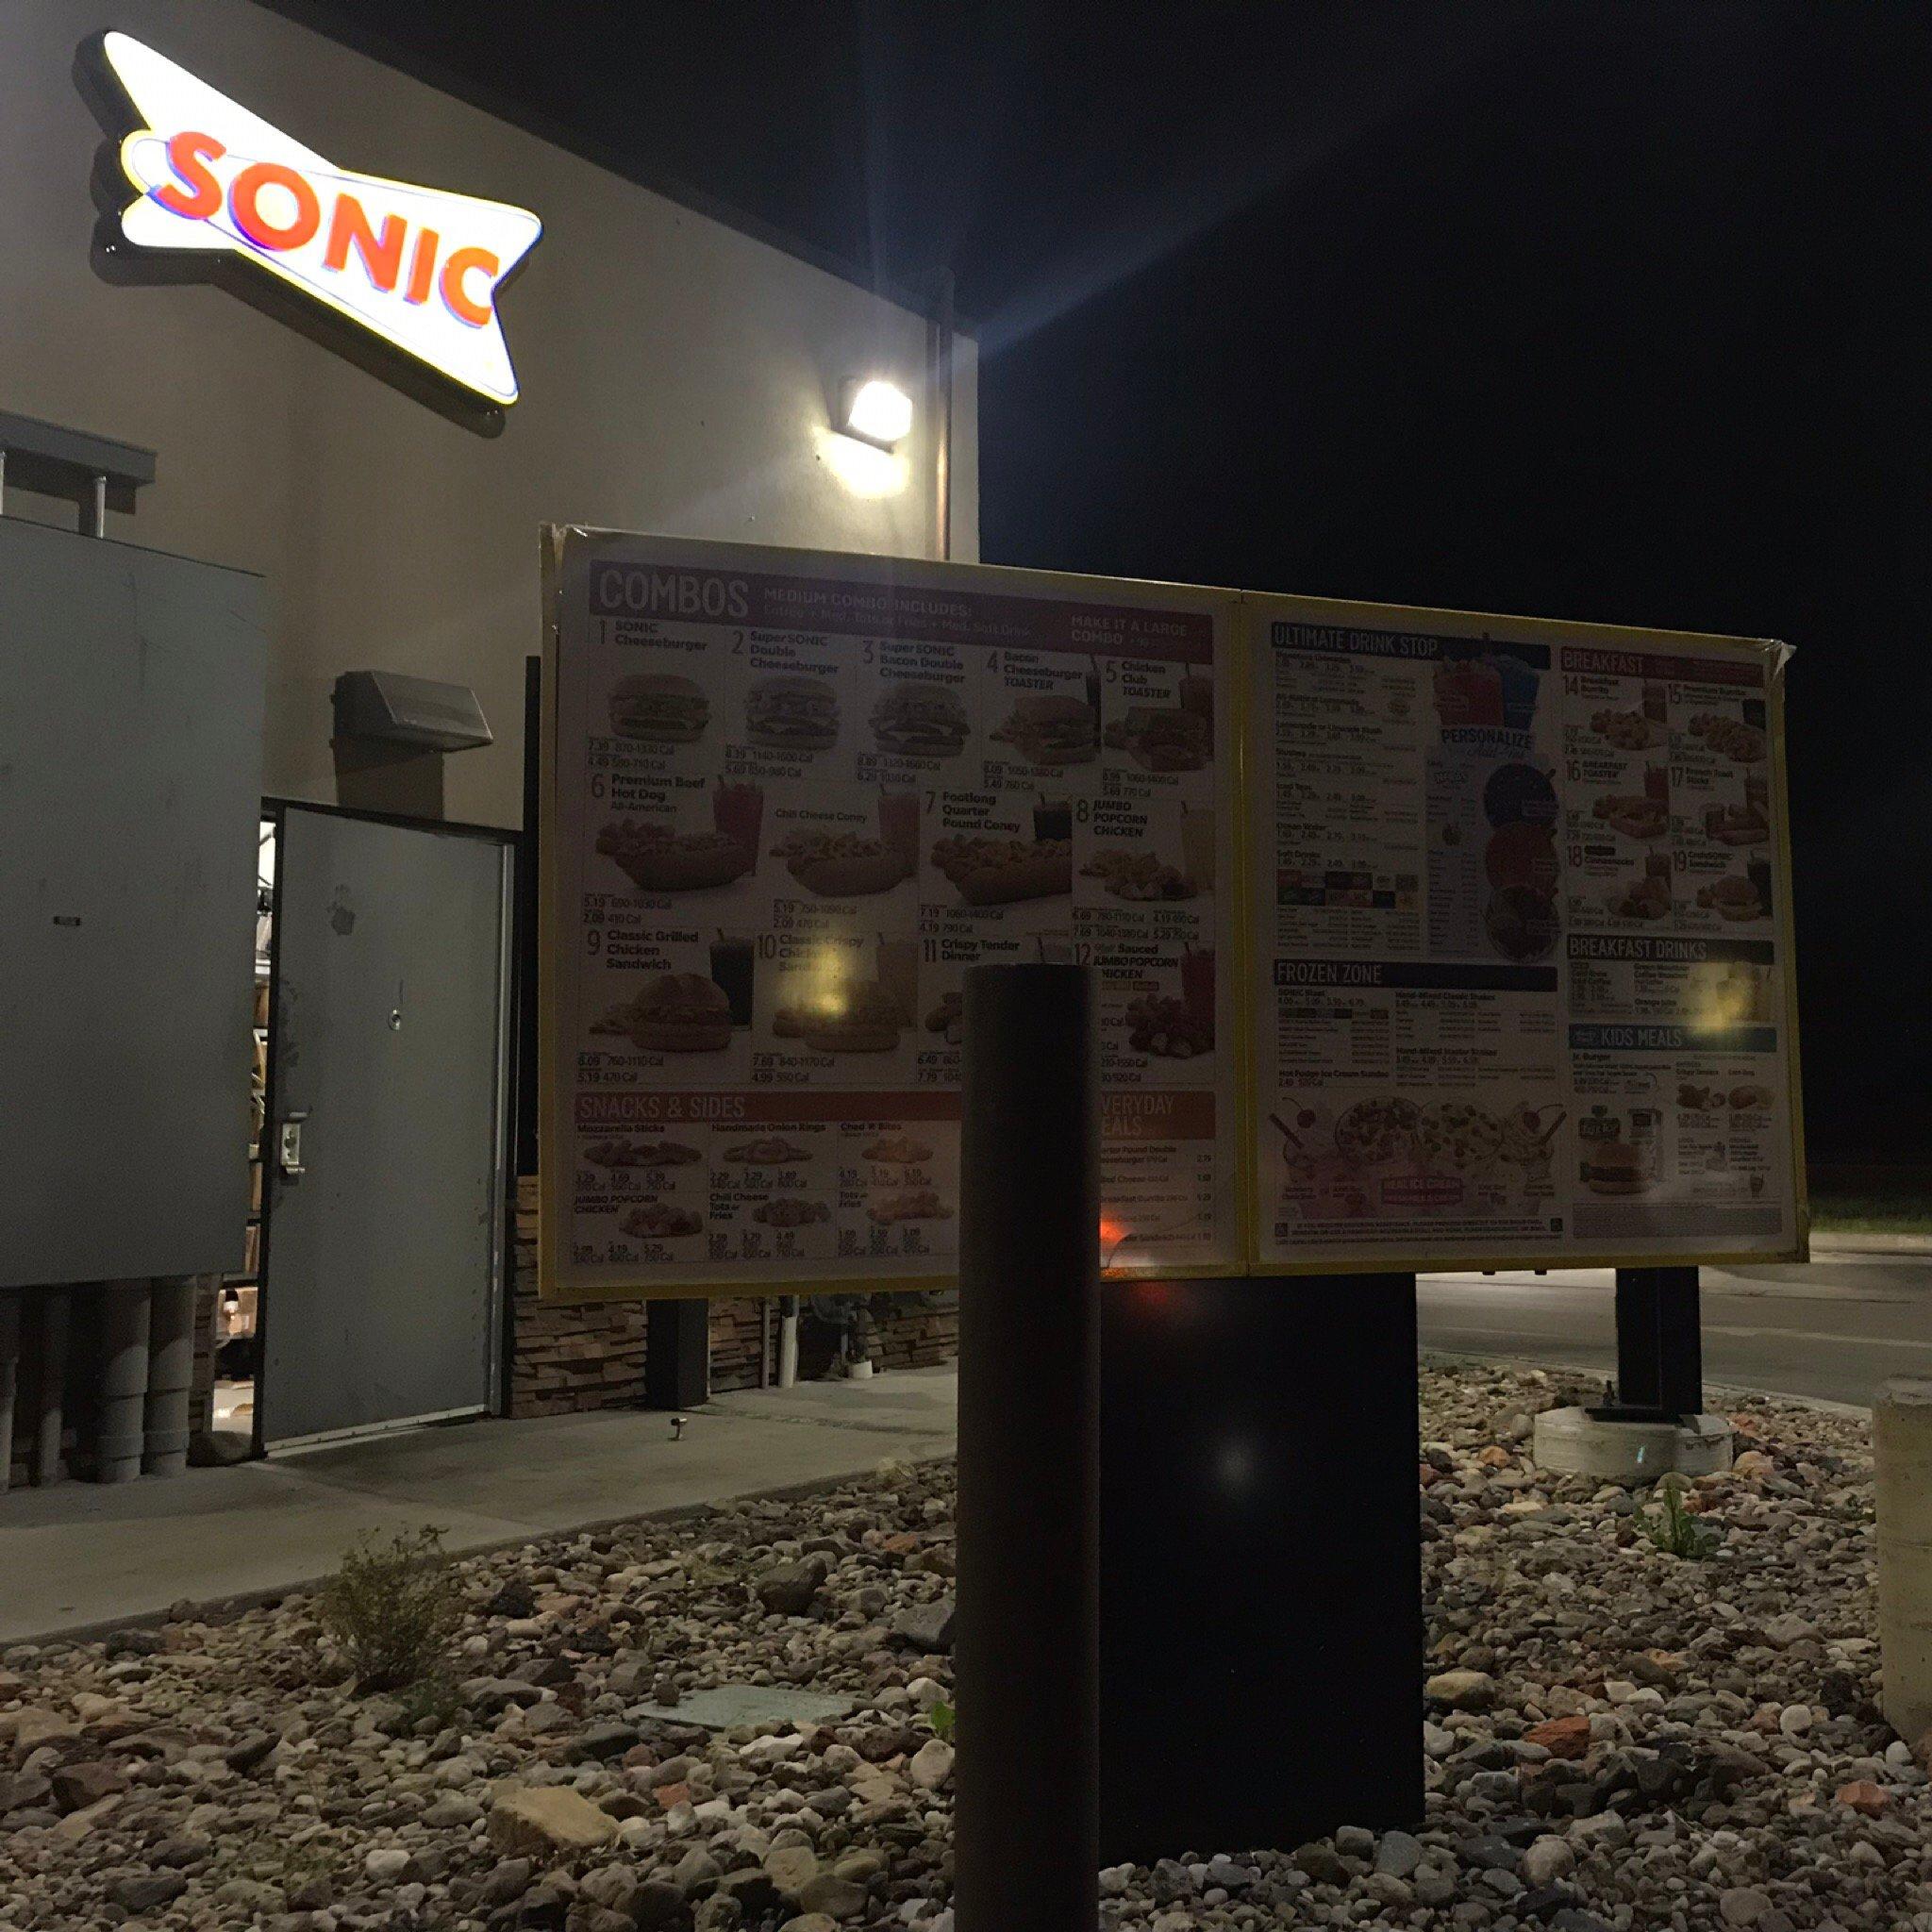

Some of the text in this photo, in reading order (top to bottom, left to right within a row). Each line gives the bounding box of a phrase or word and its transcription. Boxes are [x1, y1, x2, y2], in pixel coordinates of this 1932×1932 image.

[146, 131, 501, 327] SONIC
[599, 569, 749, 618] COMBOS
[763, 587, 972, 617] MEDIUM COMBO INCLUDES:
[599, 620, 658, 644] 1 SONIC
[1071, 615, 1189, 637] MAKE IT A LARGE
[615, 634, 708, 652] Cheeseburger
[731, 629, 828, 655] 2 Super SONIC
[1071, 629, 1124, 645] COMBO
[1274, 625, 1439, 657] ULTIMATE DRINK STOP
[750, 645, 796, 658] Double
[862, 640, 955, 664] 3 Super SONIC
[750, 658, 840, 675] Cheeseburger
[879, 654, 964, 671] Bacon Double
[987, 651, 1040, 674] 4 Bacon
[1563, 650, 1643, 674] BREAKFAST
[879, 667, 965, 684] Cheeseburger
[1004, 664, 1083, 680] Cheeseburger
[1106, 660, 1166, 683] 5 Chicken
[1122, 674, 1148, 685] Club
[1004, 676, 1054, 691] TOASTER
[1123, 686, 1172, 699] TOASTER
[1563, 675, 1578, 695] 14
[1668, 683, 1681, 705] 15
[1441, 728, 1533, 750] PERSONALIZE
[1566, 759, 1580, 781] 16
[1582, 769, 1620, 778] TOASTER
[1671, 766, 1684, 788] 17
[591, 774, 706, 798] 6 Premium Beef
[612, 788, 666, 802] Hot Dog
[611, 801, 677, 813] All-American
[925, 791, 996, 814] 7 Footlong
[942, 805, 990, 817] Quarter
[1076, 799, 1132, 823] 8 JUMBO
[774, 808, 867, 824] Chili Cheese Coney
[1093, 813, 1148, 825] POPCORN
[942, 818, 1021, 833] Pound Coney
[1093, 825, 1144, 838] CHICKEN
[1567, 845, 1582, 867] 18
[1673, 850, 1687, 872] 19
[625, 914, 641, 924] Cal
[587, 929, 699, 956] 9 Classic Grilled
[607, 943, 660, 956] Chicken
[757, 934, 777, 959] 10
[924, 939, 1020, 963] 11 Crispy Tender
[1570, 938, 1707, 960] BREAKFAST DRINKS
[941, 950, 981, 961] Dinner
[1074, 943, 1158, 966] 12 Sauced
[1092, 956, 1179, 968] JUMBO POPCORN
[606, 958, 672, 971] Sandwich
[1277, 962, 1382, 984] FROZEN ZONE
[1601, 1027, 1683, 1047] KIDS MEALS
[1583, 1053, 1611, 1062] Burger
[621, 1072, 638, 1083] Cal
[794, 1072, 809, 1083] Cal
[579, 1095, 745, 1119] SNACKS & SIDES
[1101, 1094, 1174, 1115] VERYDAY
[577, 1124, 665, 1133] Mozzarella Sticks
[711, 1123, 826, 1134] Handmade Onion Rings
[1101, 1115, 1142, 1137] EALS
[575, 1194, 658, 1205] JUMBO POPCORN
[709, 1192, 769, 1202] Chili Cheese
[574, 1204, 619, 1214] CHICKEN
[709, 1210, 734, 1221] Fries
